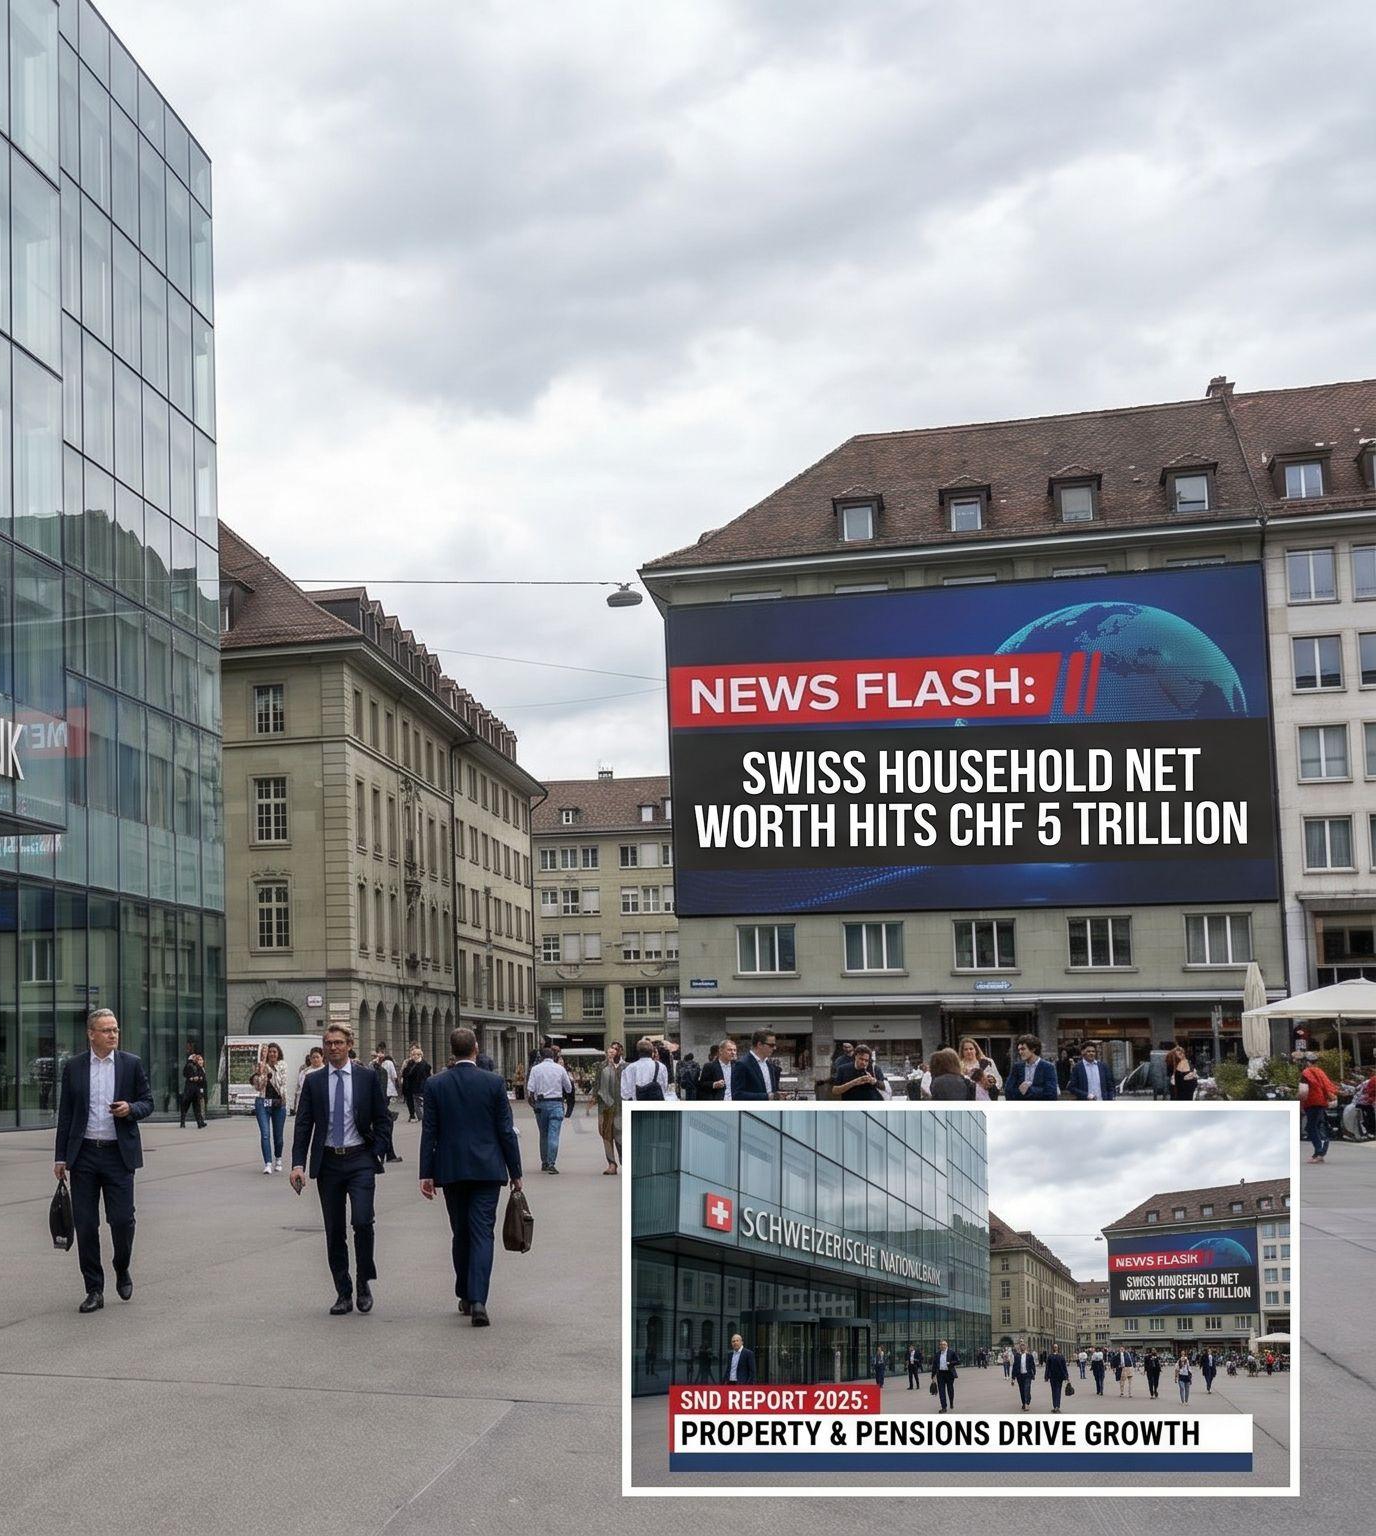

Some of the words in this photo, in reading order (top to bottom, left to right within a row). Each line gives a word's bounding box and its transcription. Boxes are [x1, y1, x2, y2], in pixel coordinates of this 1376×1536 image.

[690, 673, 840, 715] NEWS
[857, 667, 1036, 708] FLASH:
[742, 750, 867, 796] SWISS
[879, 748, 1113, 794] HOUSEHOLD
[1125, 747, 1202, 793] NET
[695, 803, 836, 849] WORTH
[849, 802, 938, 847] HITS
[949, 801, 1025, 846] CHF
[1037, 801, 1062, 846] 5
[1073, 800, 1249, 845] TRILLION
